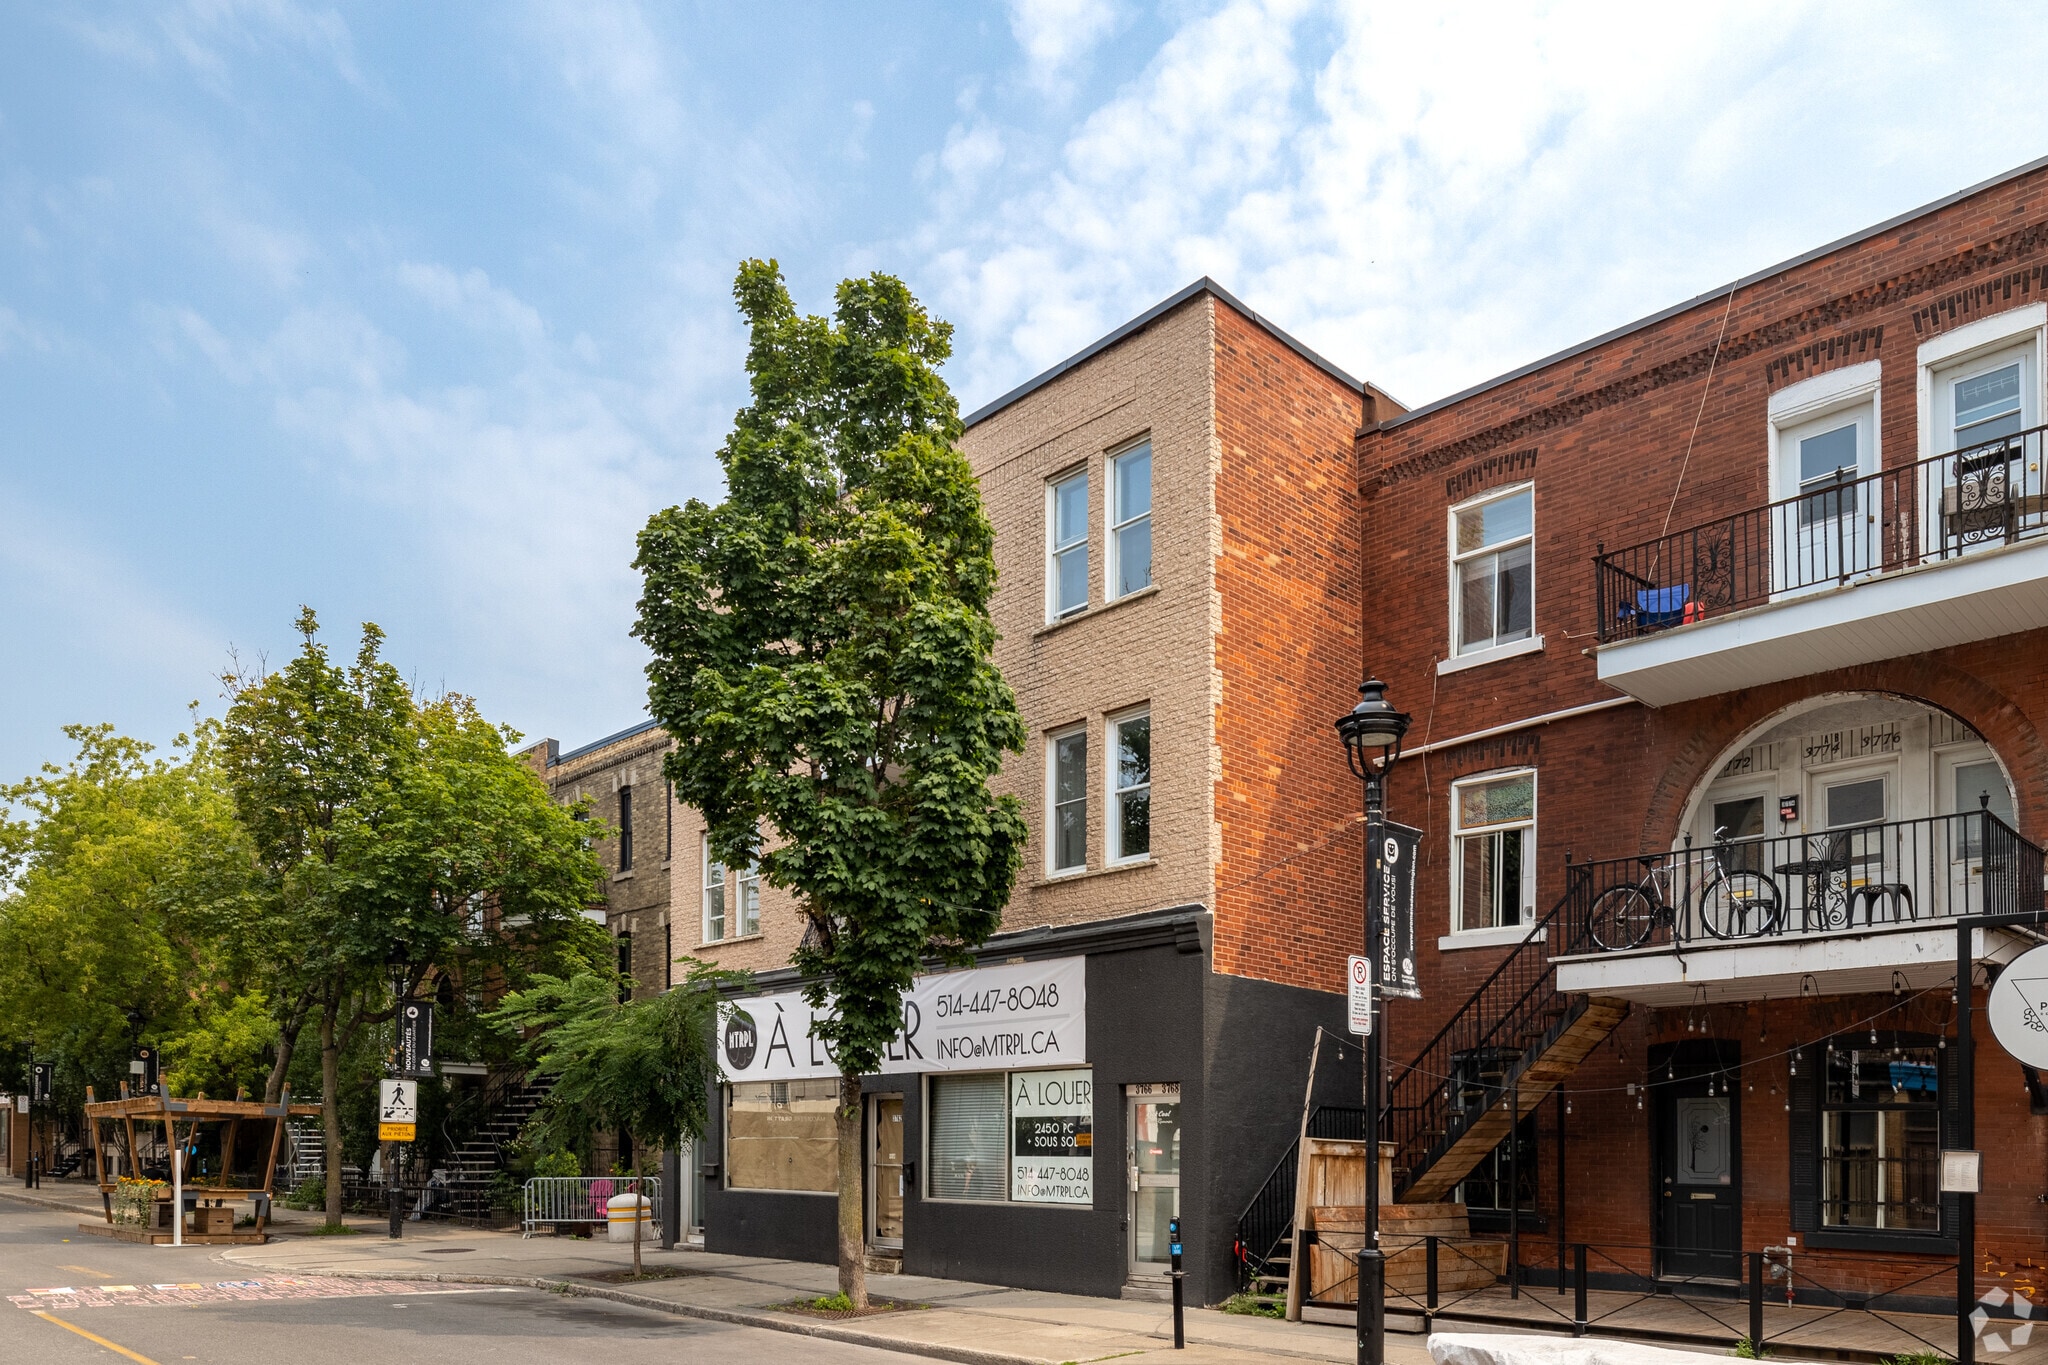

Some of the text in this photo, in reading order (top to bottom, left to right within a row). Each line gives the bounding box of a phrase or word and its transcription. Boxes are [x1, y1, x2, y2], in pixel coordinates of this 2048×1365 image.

[1861, 732, 1900, 748] 3776
[1804, 742, 1840, 759] 3774
[1391, 905, 1397, 918] DE
[1391, 967, 1397, 982] ON
[936, 983, 1059, 1018] 514-447-8048
[764, 1002, 795, 1070] À
[936, 1030, 1060, 1060] INFO@MTRPL.CA
[1015, 1077, 1091, 1106] À LOUER
[1135, 1084, 1153, 1095] 3766
[1161, 1083, 1179, 1094] 3768
[1034, 1122, 1074, 1134] 2450 PC
[1034, 1136, 1058, 1147] SOUS
[1060, 1136, 1078, 1148] SOL
[1017, 1184, 1090, 1199] INFO@MTRPL.CA
